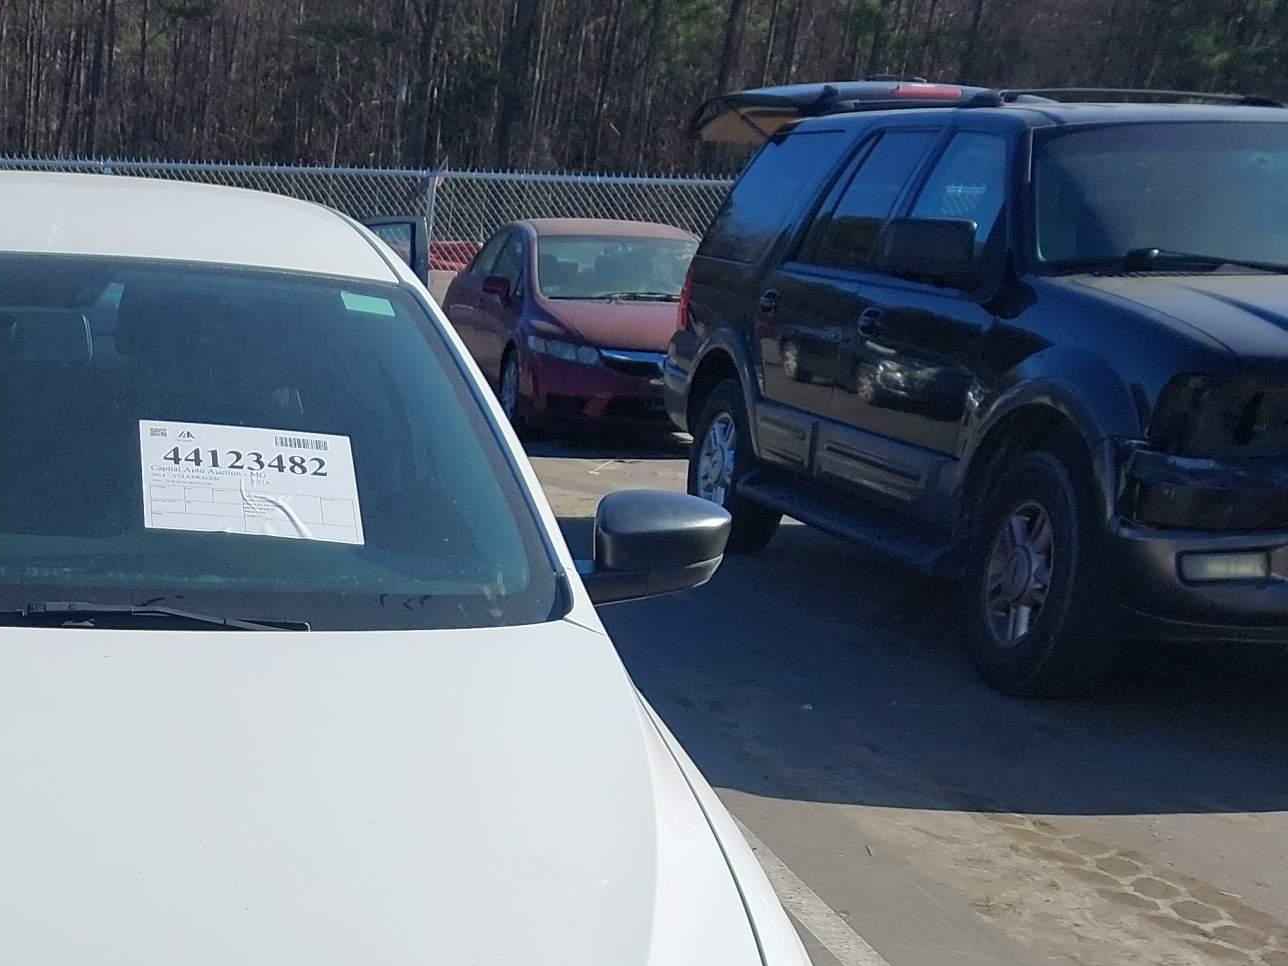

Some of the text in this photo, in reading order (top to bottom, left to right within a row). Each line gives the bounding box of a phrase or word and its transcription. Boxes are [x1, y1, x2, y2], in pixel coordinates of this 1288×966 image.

[151, 464, 181, 474] Capital
[208, 468, 242, 477] Auction
[163, 446, 328, 477] 44123482
